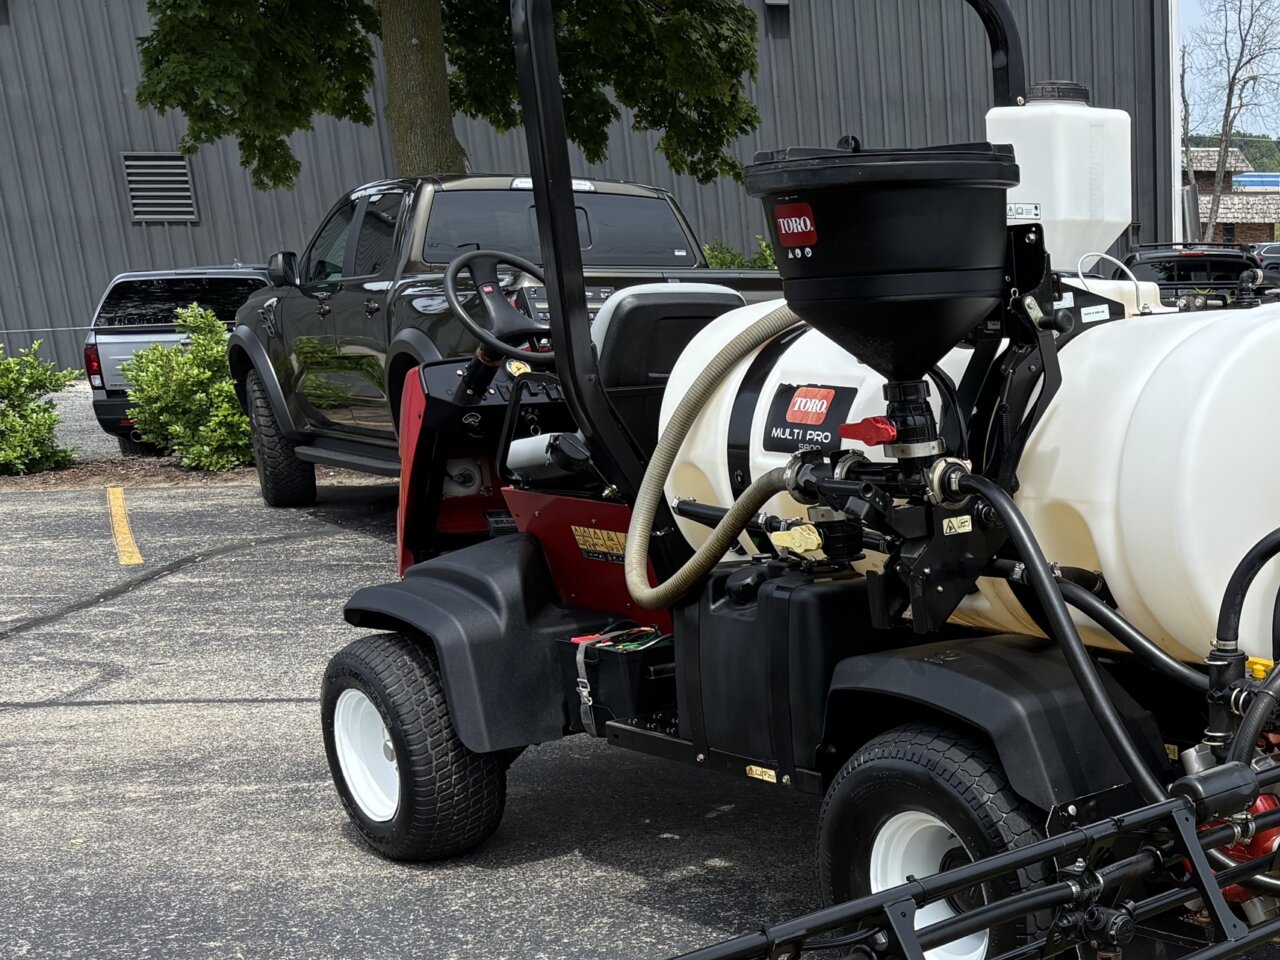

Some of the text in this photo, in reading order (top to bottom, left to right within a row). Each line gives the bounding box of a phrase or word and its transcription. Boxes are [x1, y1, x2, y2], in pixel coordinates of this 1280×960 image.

[777, 216, 812, 233] TORO
[793, 398, 827, 413] TORO
[771, 427, 831, 443] MULTI PRO
